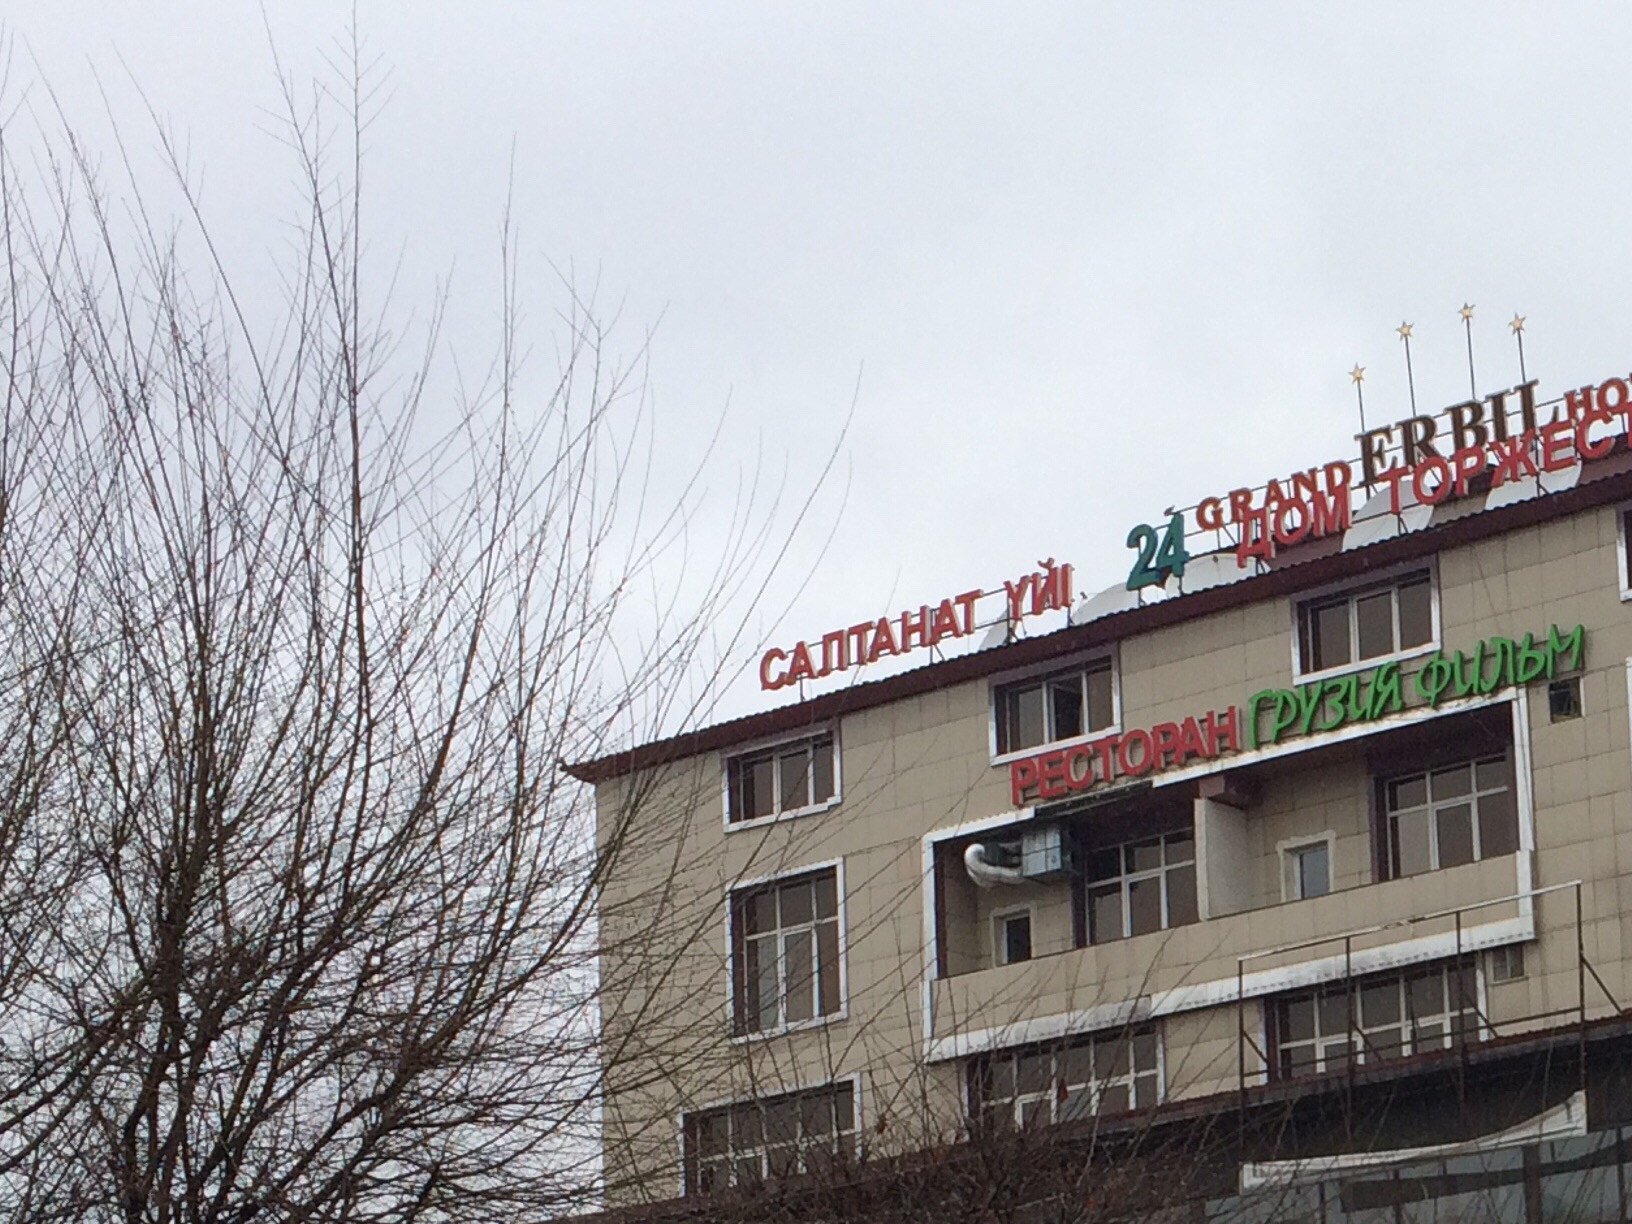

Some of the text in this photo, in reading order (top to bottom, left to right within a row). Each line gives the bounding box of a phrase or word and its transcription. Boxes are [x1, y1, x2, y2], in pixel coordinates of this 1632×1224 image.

[1196, 460, 1351, 530] GRAND
[1235, 483, 1352, 568] ДОМ
[1126, 512, 1190, 591] 24
[1011, 624, 1584, 805] РЕСТОРАН ГРУЗИЯ ФИЛЬМ
